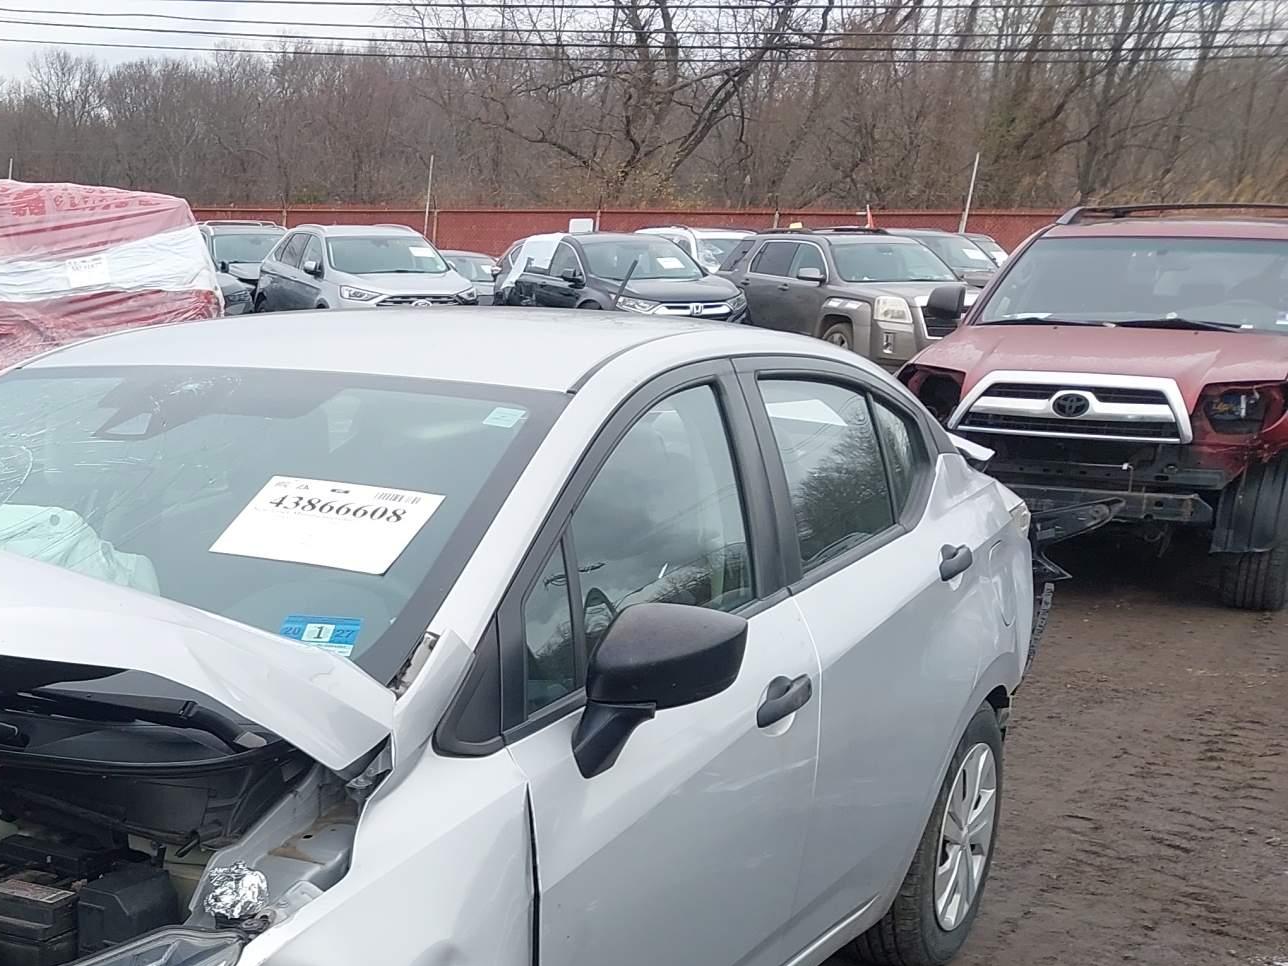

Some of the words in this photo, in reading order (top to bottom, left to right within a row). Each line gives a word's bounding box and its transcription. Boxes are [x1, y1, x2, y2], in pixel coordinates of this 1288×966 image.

[269, 494, 408, 523] 43866608
[284, 627, 301, 635] 20
[313, 626, 324, 639] 1
[335, 629, 354, 638] 27
